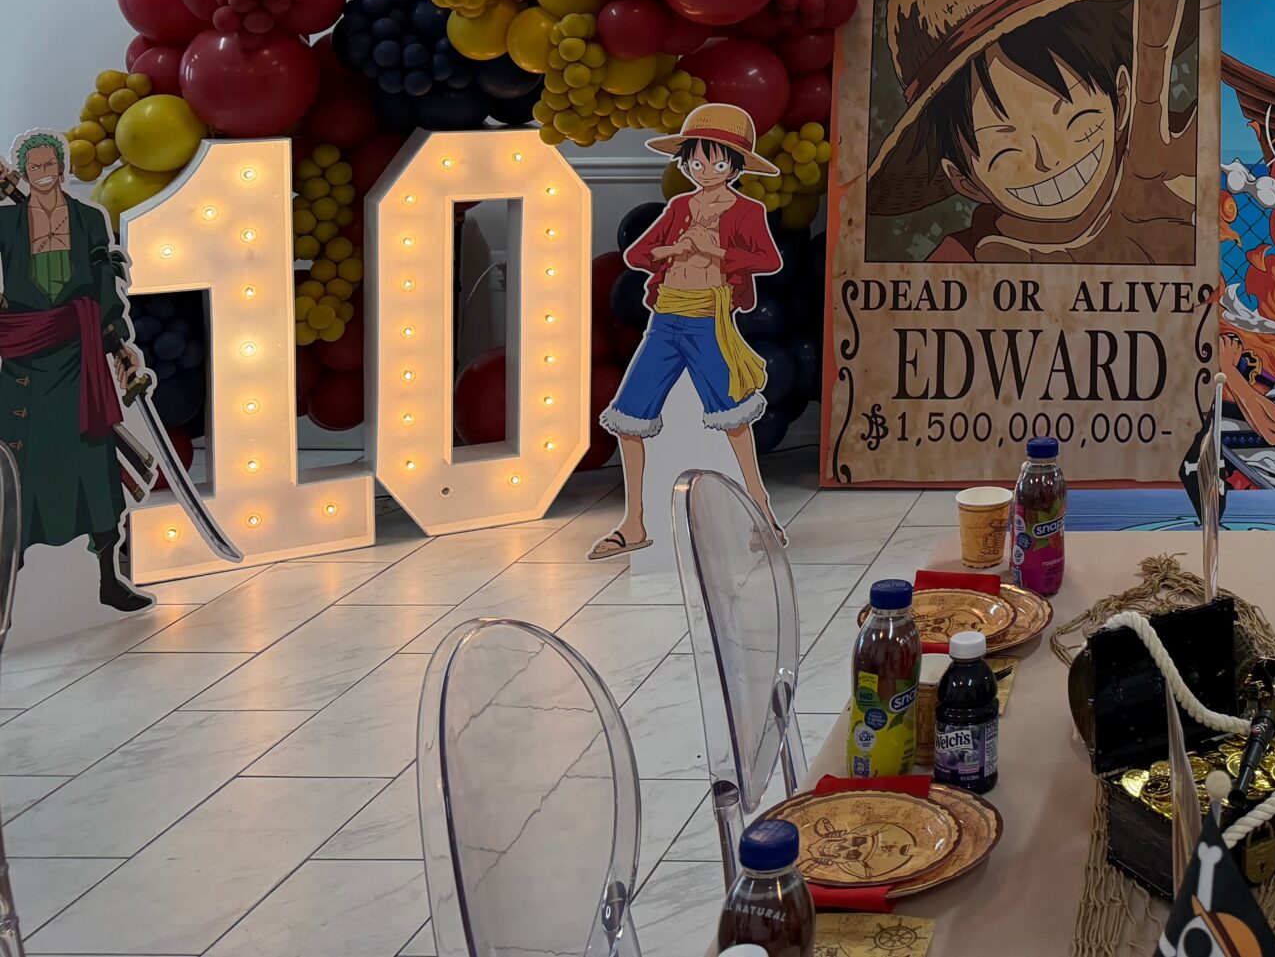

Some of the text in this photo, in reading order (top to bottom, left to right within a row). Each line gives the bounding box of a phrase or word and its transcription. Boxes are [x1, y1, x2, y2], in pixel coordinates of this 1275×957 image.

[860, 279, 1195, 313] DEAD OR ALIVE
[121, 128, 592, 585] 10
[891, 328, 1168, 402] EDWARD
[735, 902, 787, 923] NATURAL
